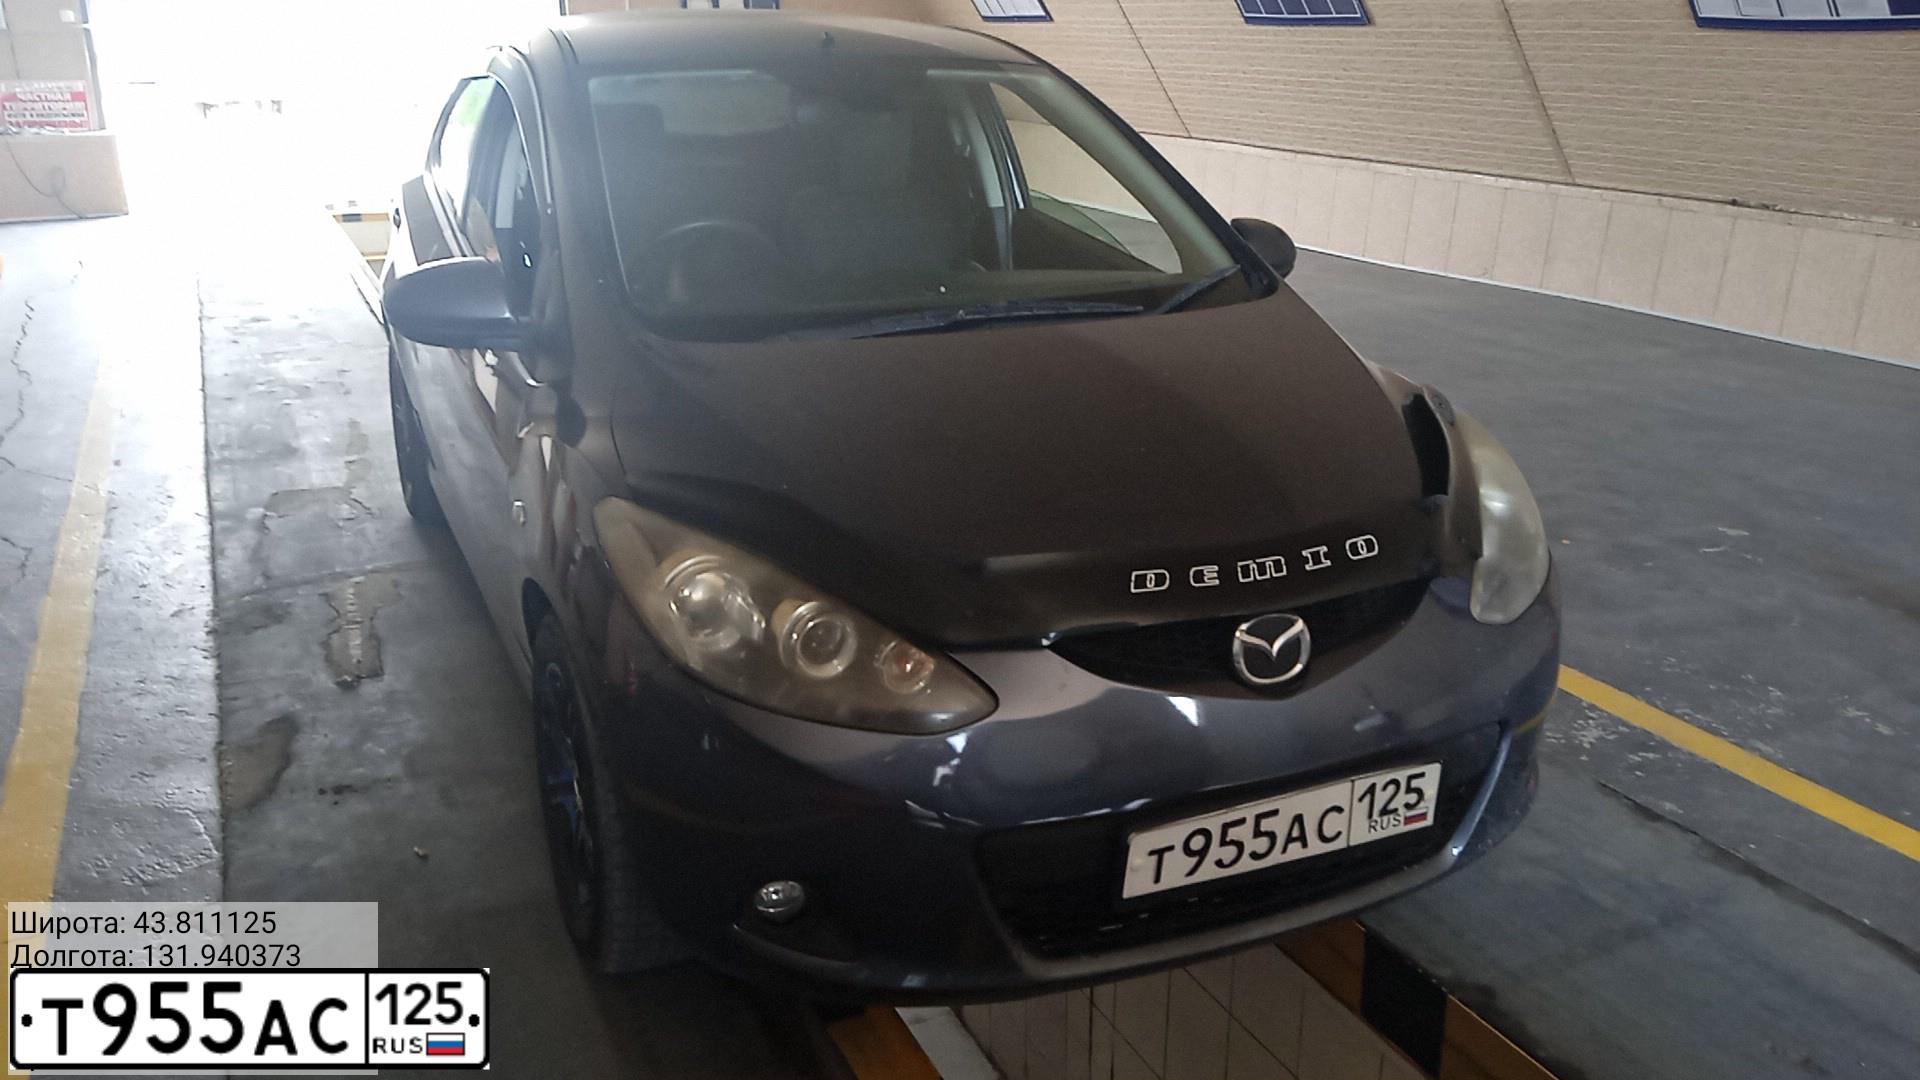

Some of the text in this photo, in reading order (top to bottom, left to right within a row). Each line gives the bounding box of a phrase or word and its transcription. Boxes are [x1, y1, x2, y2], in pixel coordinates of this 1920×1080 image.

[1130, 535, 1378, 593] DEMIO
[1358, 772, 1426, 820] 125
[1367, 813, 1402, 834] RUS
